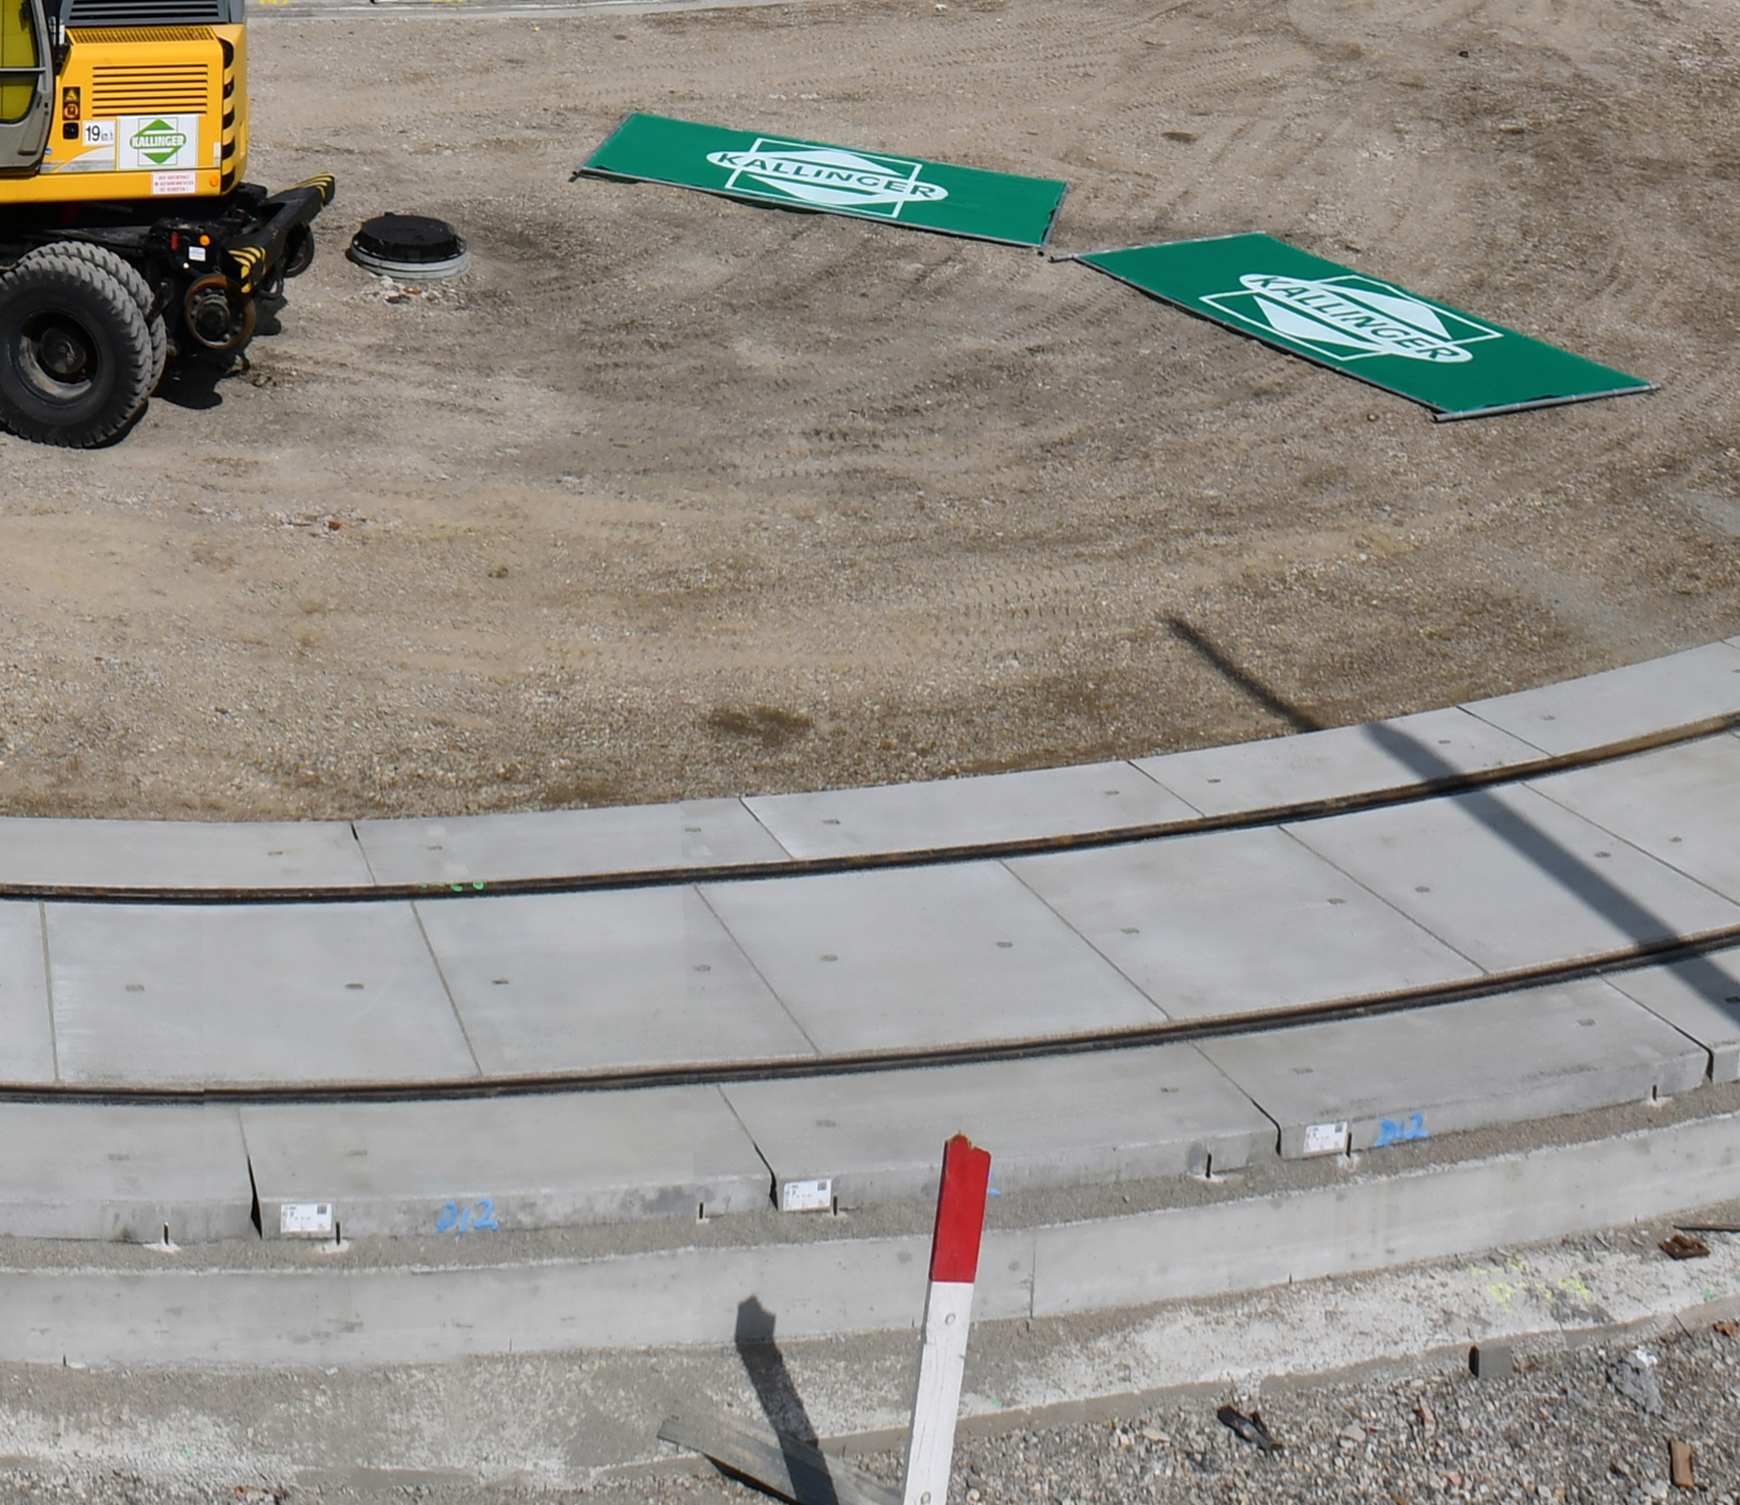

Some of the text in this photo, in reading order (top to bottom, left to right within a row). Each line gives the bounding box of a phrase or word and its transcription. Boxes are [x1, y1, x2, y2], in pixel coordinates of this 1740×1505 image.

[85, 125, 101, 142] 19
[131, 135, 185, 148] KALLINGER
[714, 148, 938, 200] KALLINGER
[1245, 272, 1470, 365] KALLINGER
